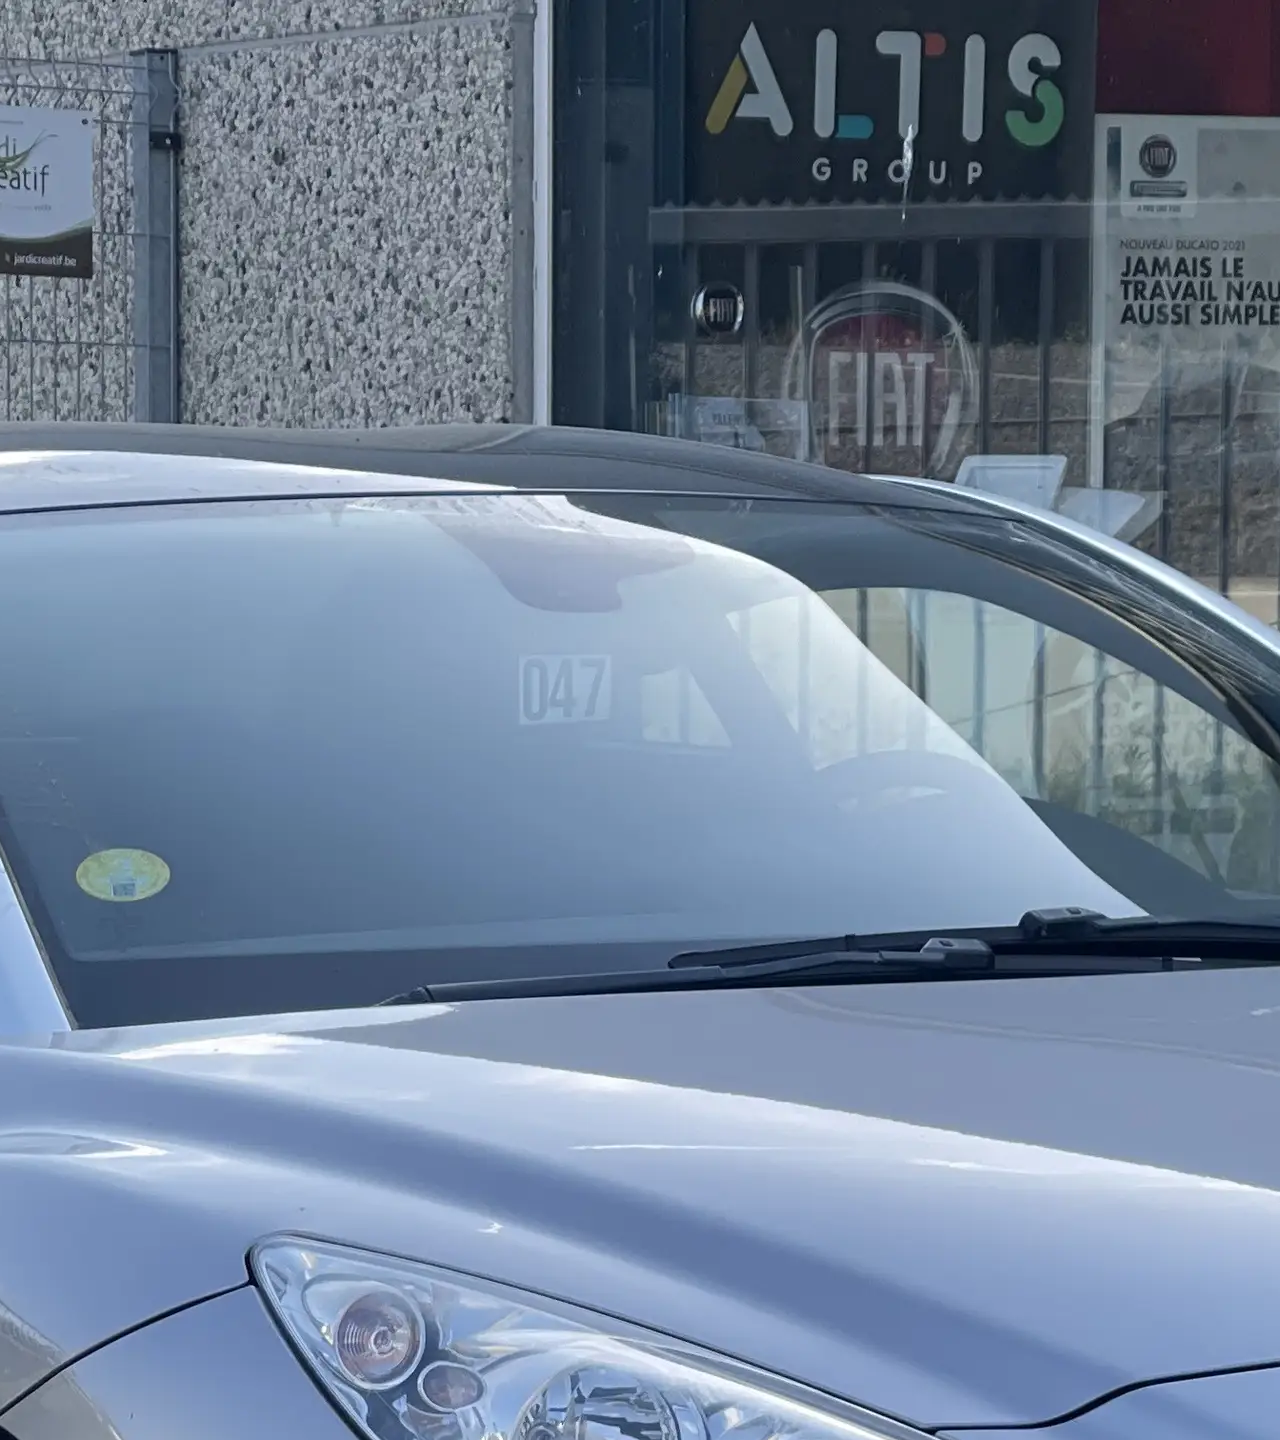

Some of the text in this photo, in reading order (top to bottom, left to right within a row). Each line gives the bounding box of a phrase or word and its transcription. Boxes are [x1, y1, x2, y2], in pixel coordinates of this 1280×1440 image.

[705, 21, 1064, 146] ALTIS
[812, 157, 983, 184] GROUP
[1120, 239, 1245, 251] NOUVEAU DUCATO 2021
[1120, 256, 1244, 278] JAMAIS LE
[1120, 280, 1218, 301] TRAVAIL
[1120, 304, 1280, 325] AUSSI SIMPLE
[828, 352, 935, 446] FIAT
[522, 658, 607, 721] 047
